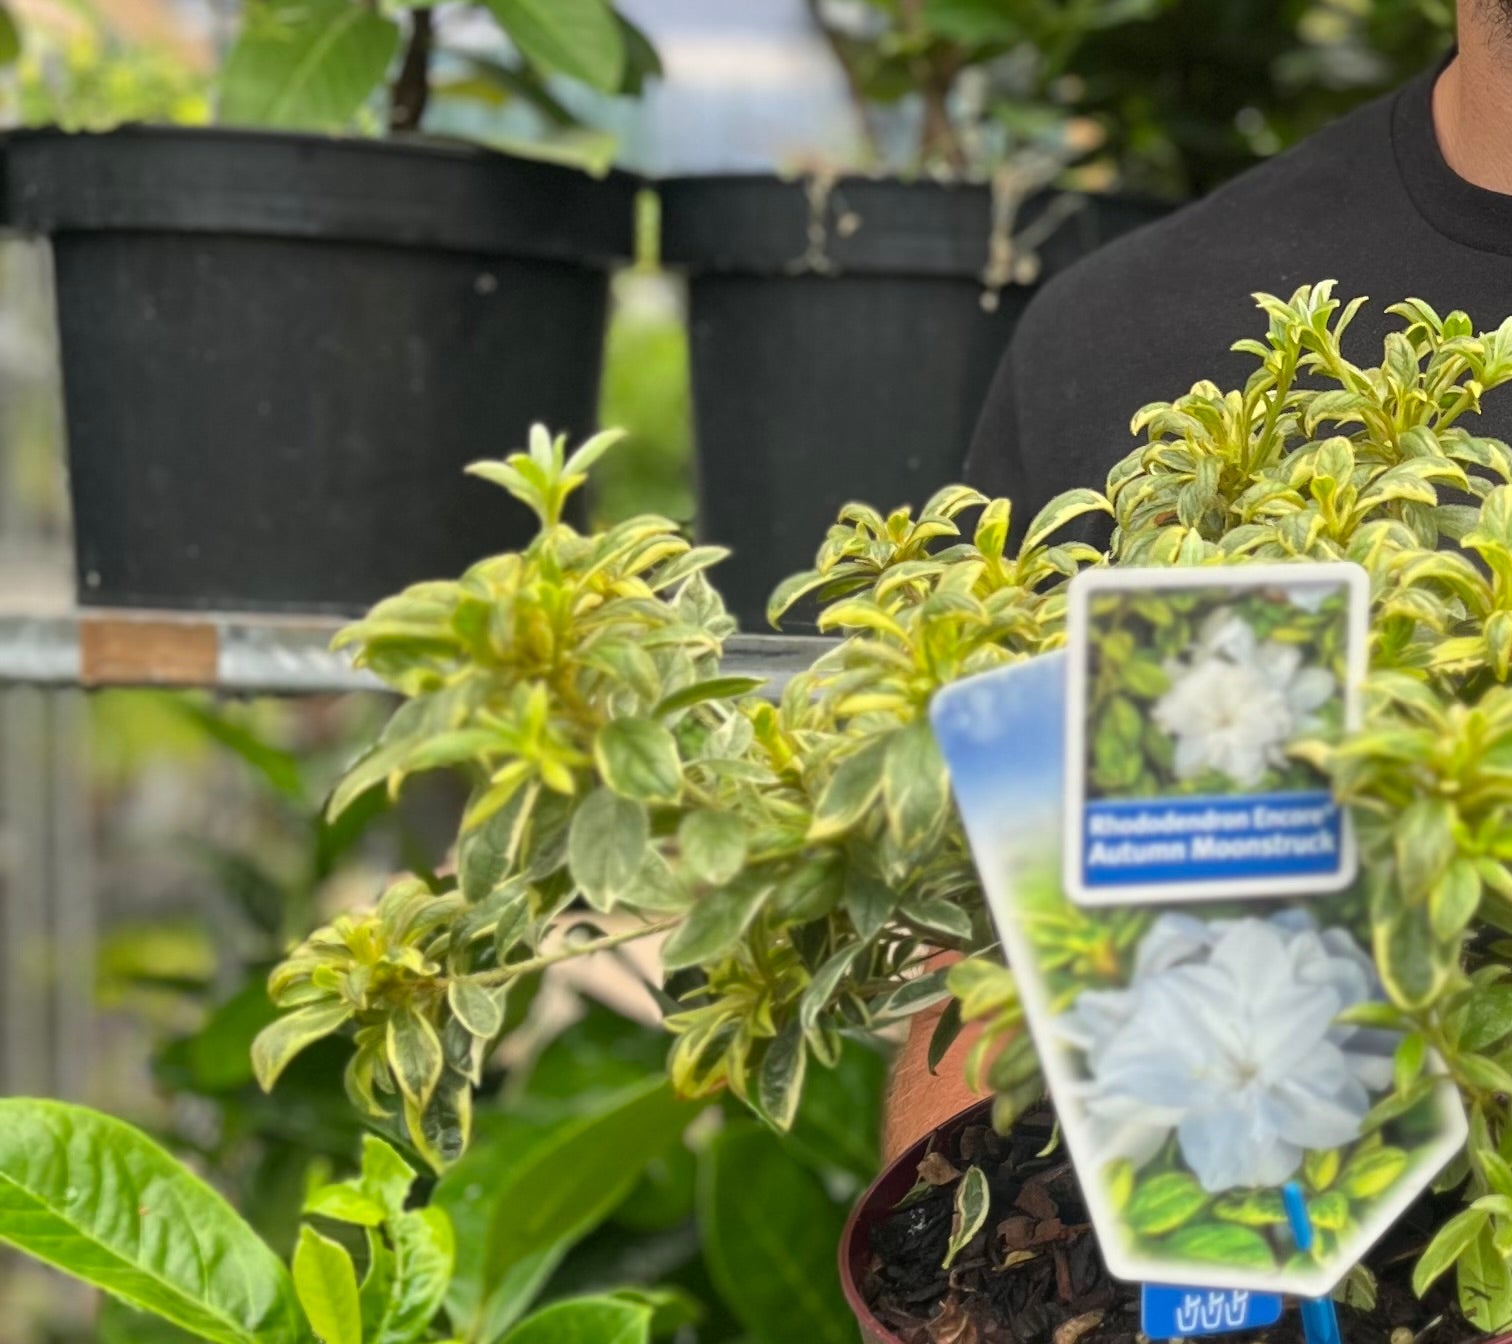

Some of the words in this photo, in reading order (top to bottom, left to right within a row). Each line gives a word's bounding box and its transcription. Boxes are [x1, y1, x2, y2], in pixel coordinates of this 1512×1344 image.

[1088, 808, 1250, 837] Rhododendron
[1088, 838, 1187, 866] Autumn
[1190, 828, 1337, 861] Moonstruck
